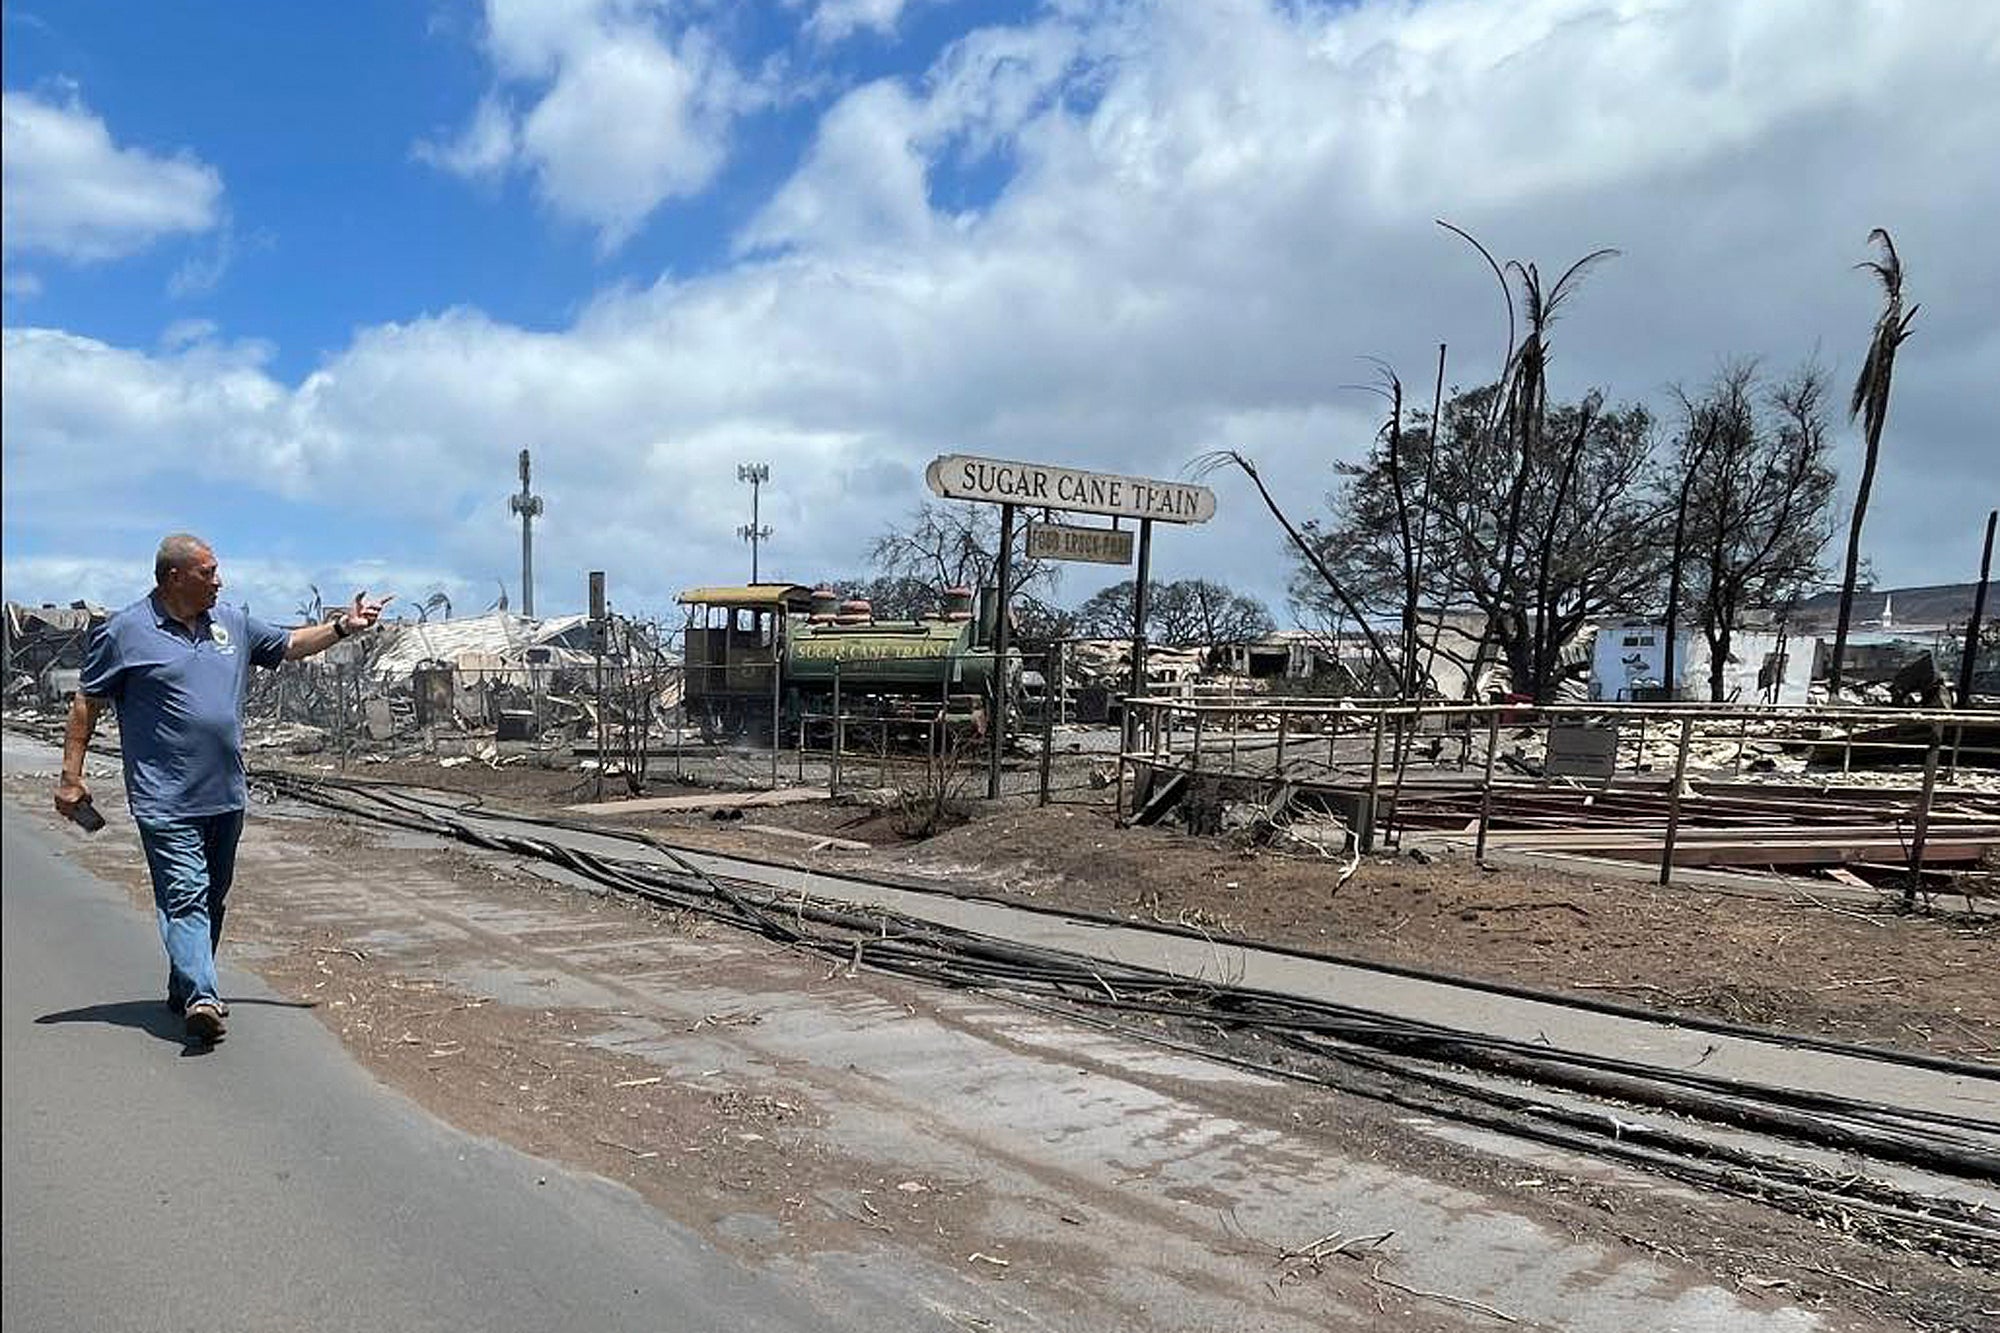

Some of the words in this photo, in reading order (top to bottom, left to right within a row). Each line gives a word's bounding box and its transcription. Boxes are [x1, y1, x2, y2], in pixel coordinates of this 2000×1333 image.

[962, 463, 1048, 499] SUGAR
[1057, 475, 1122, 507] CANE
[798, 644, 846, 659] SUGAR
[849, 645, 889, 659] CANE
[895, 645, 942, 658] TRAIN
